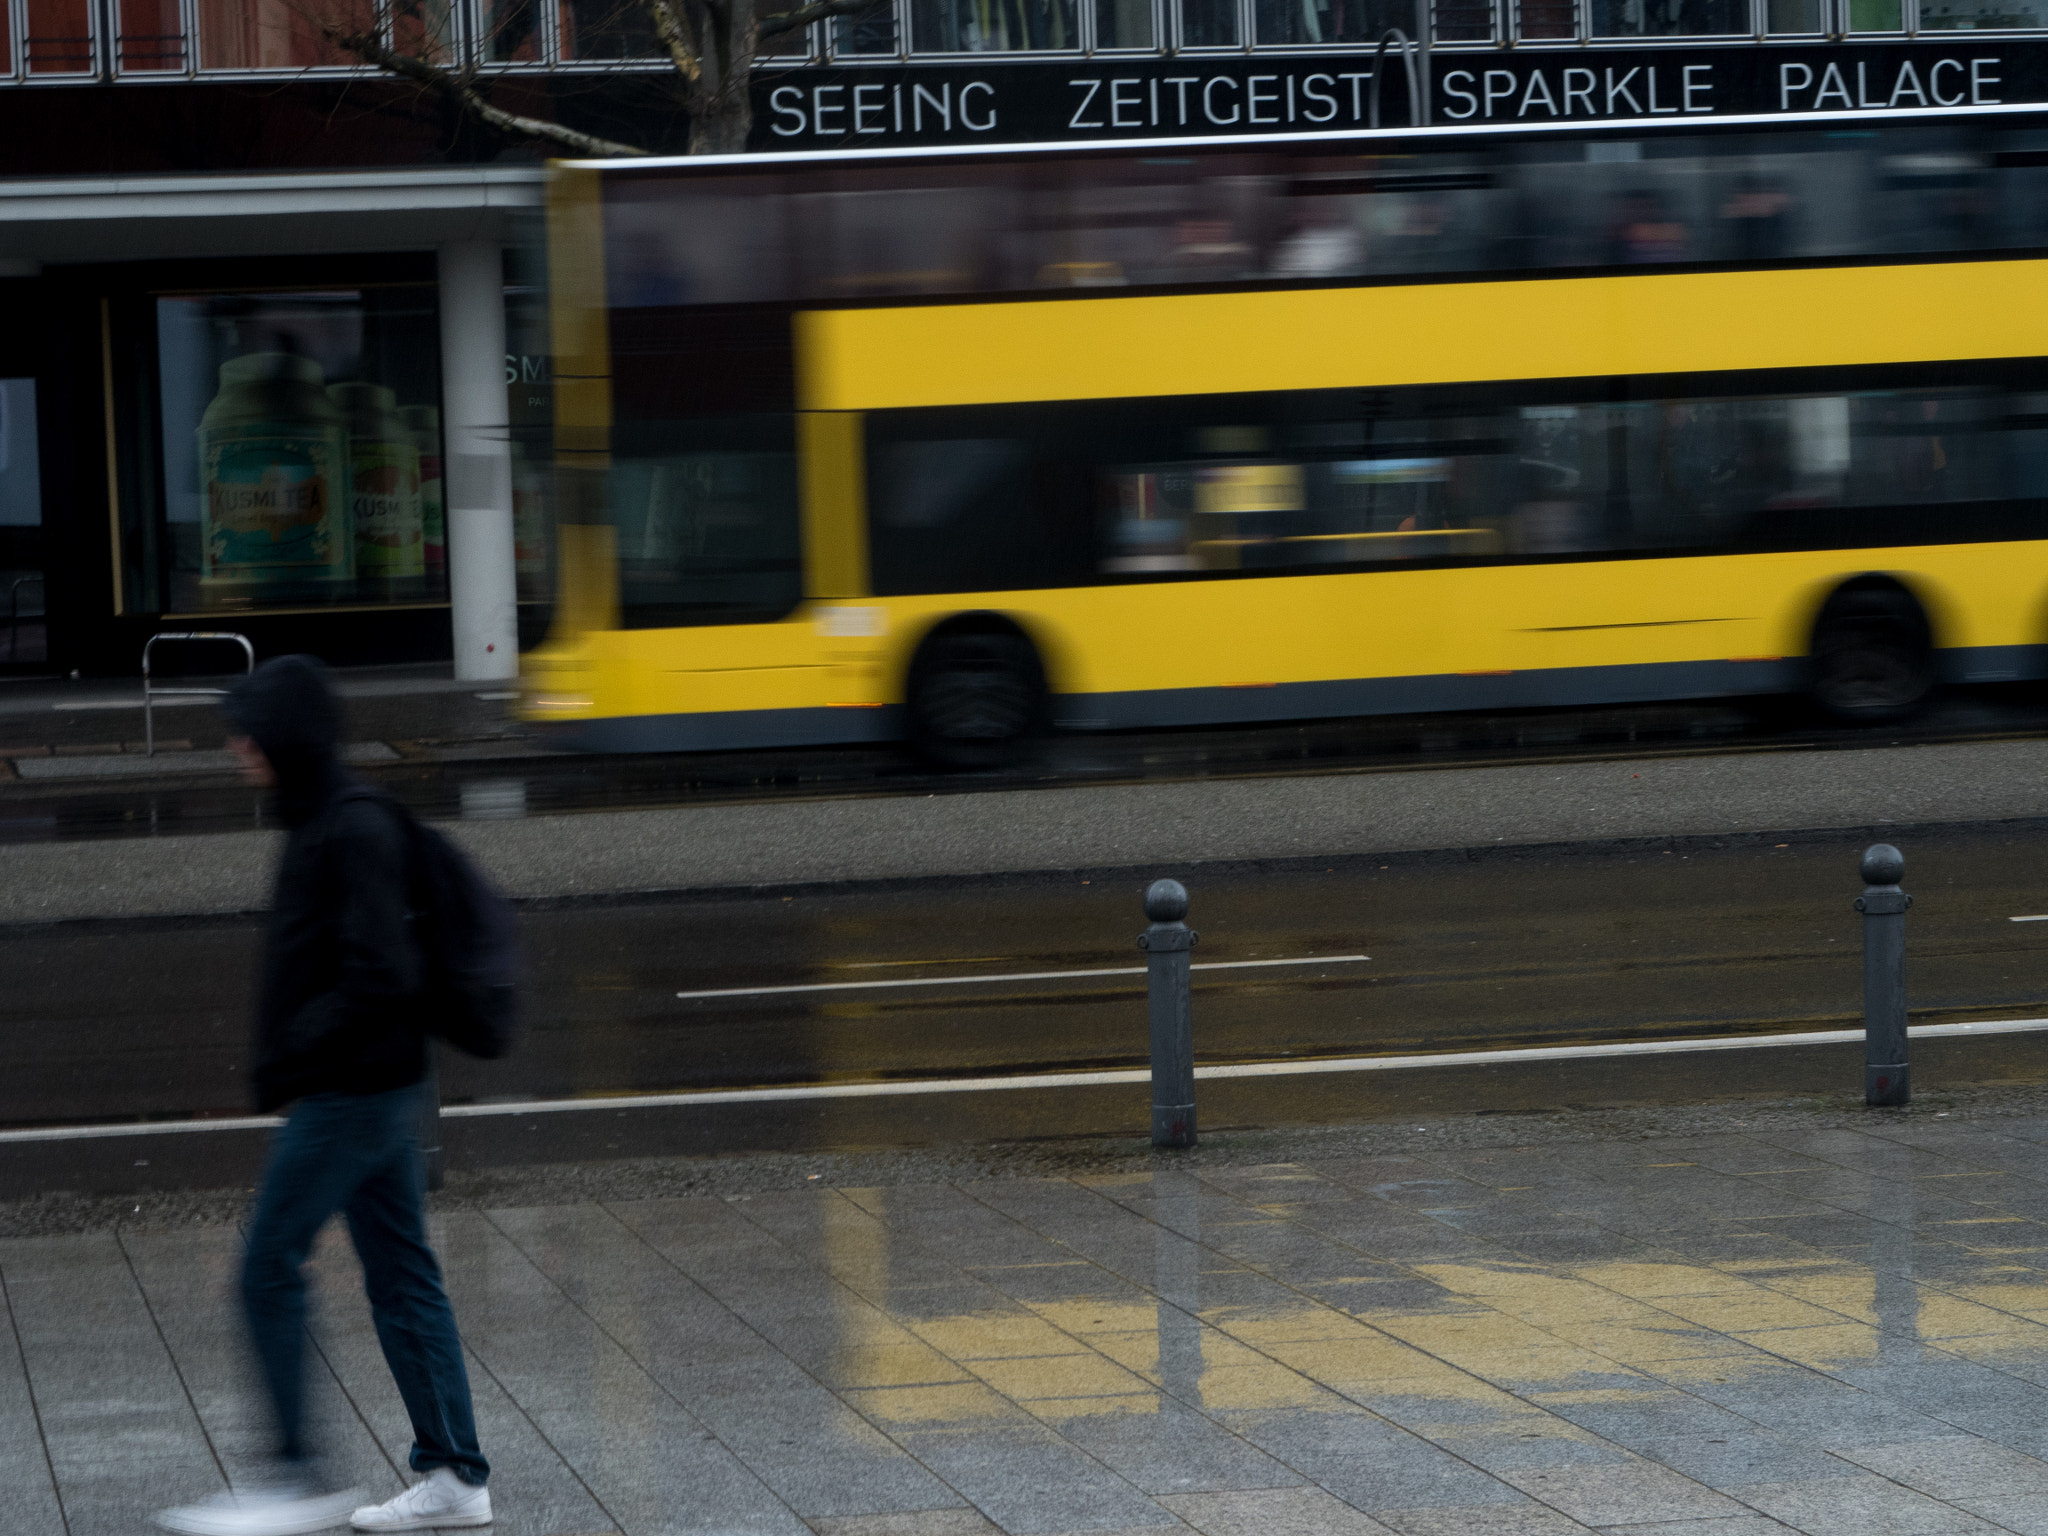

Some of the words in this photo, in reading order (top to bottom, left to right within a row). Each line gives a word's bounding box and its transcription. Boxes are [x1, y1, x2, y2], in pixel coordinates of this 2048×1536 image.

[769, 81, 997, 137] SEEING
[1068, 72, 1373, 129] ZEITGEIST
[1442, 64, 1714, 120] SPARKLE
[1779, 58, 2003, 109] PALACE
[215, 489, 276, 513] KUSMI
[286, 484, 322, 511] TEA
[353, 497, 401, 519] KUSM
